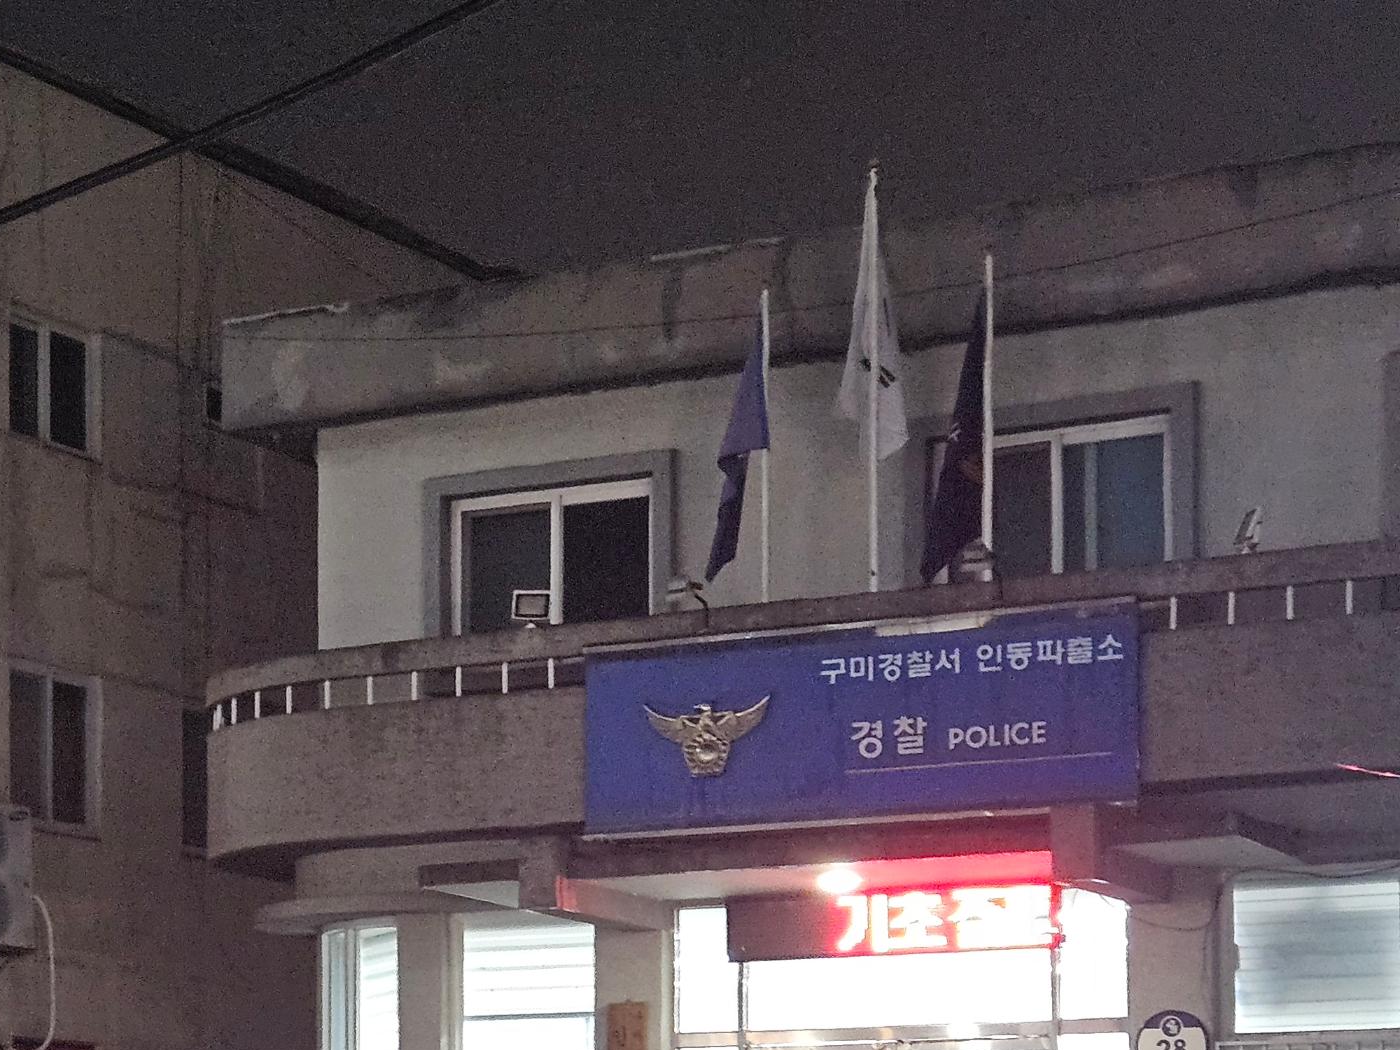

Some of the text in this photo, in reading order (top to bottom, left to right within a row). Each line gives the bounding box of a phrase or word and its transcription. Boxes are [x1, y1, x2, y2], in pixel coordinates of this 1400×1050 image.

[820, 634, 1124, 684] 구미경찰서 인동파출소
[851, 715, 1048, 759] 경찰 POLICE
